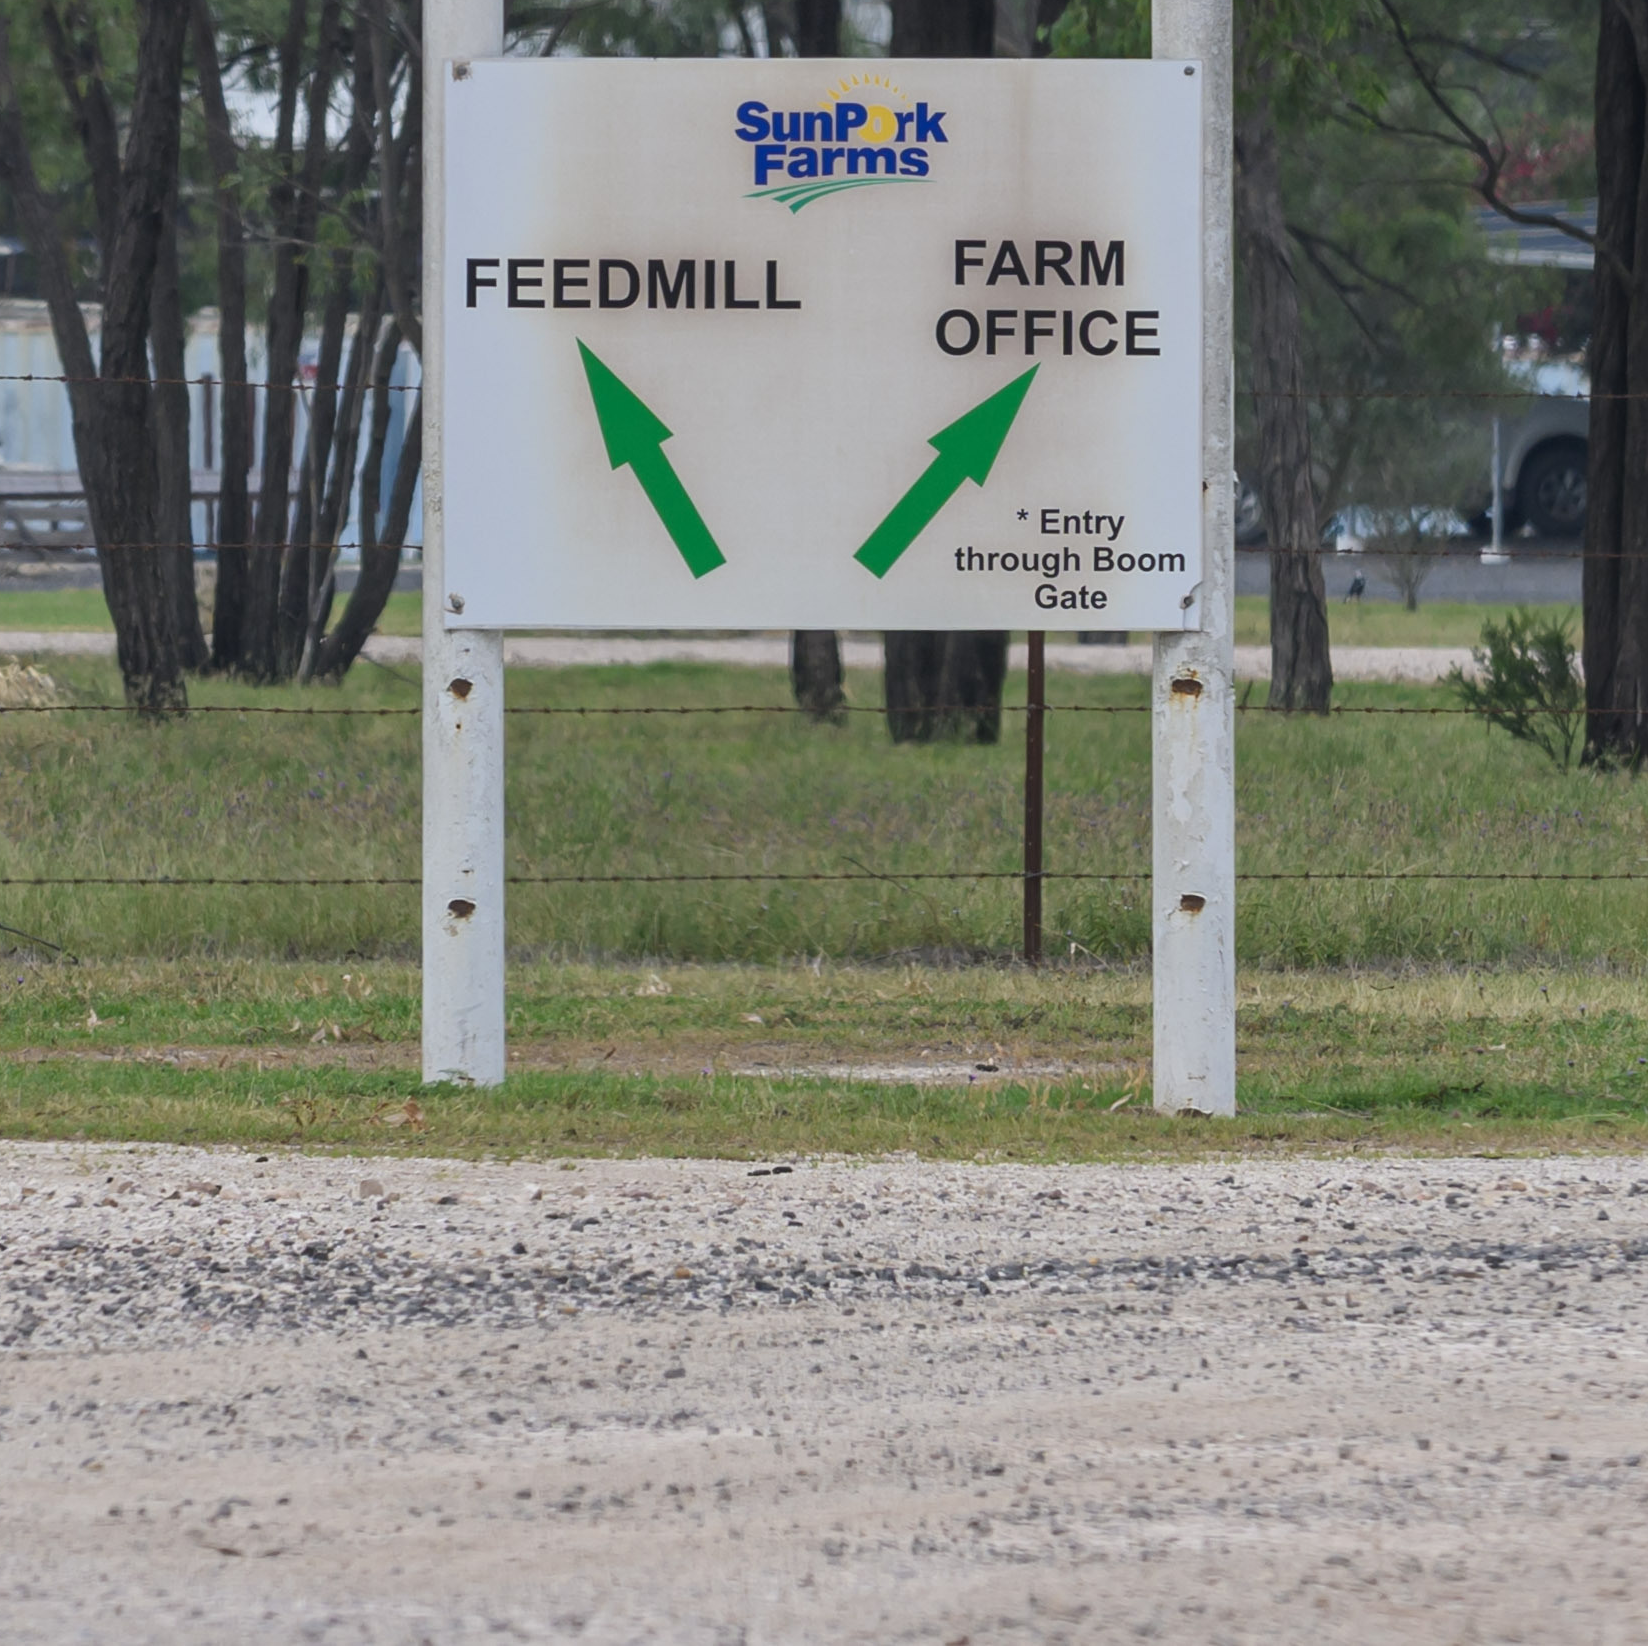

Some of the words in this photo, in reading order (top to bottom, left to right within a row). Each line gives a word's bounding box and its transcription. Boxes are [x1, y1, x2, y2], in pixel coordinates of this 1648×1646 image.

[734, 100, 949, 144] SunPork
[754, 144, 930, 186] Farms
[465, 258, 802, 310] FEEDMILL
[954, 239, 1126, 287] FARM
[935, 308, 1162, 357] OFFICE
[1040, 508, 1125, 542] Entry
[954, 545, 1082, 579] through
[1092, 546, 1186, 573] Boom
[1034, 583, 1108, 611] Gate
